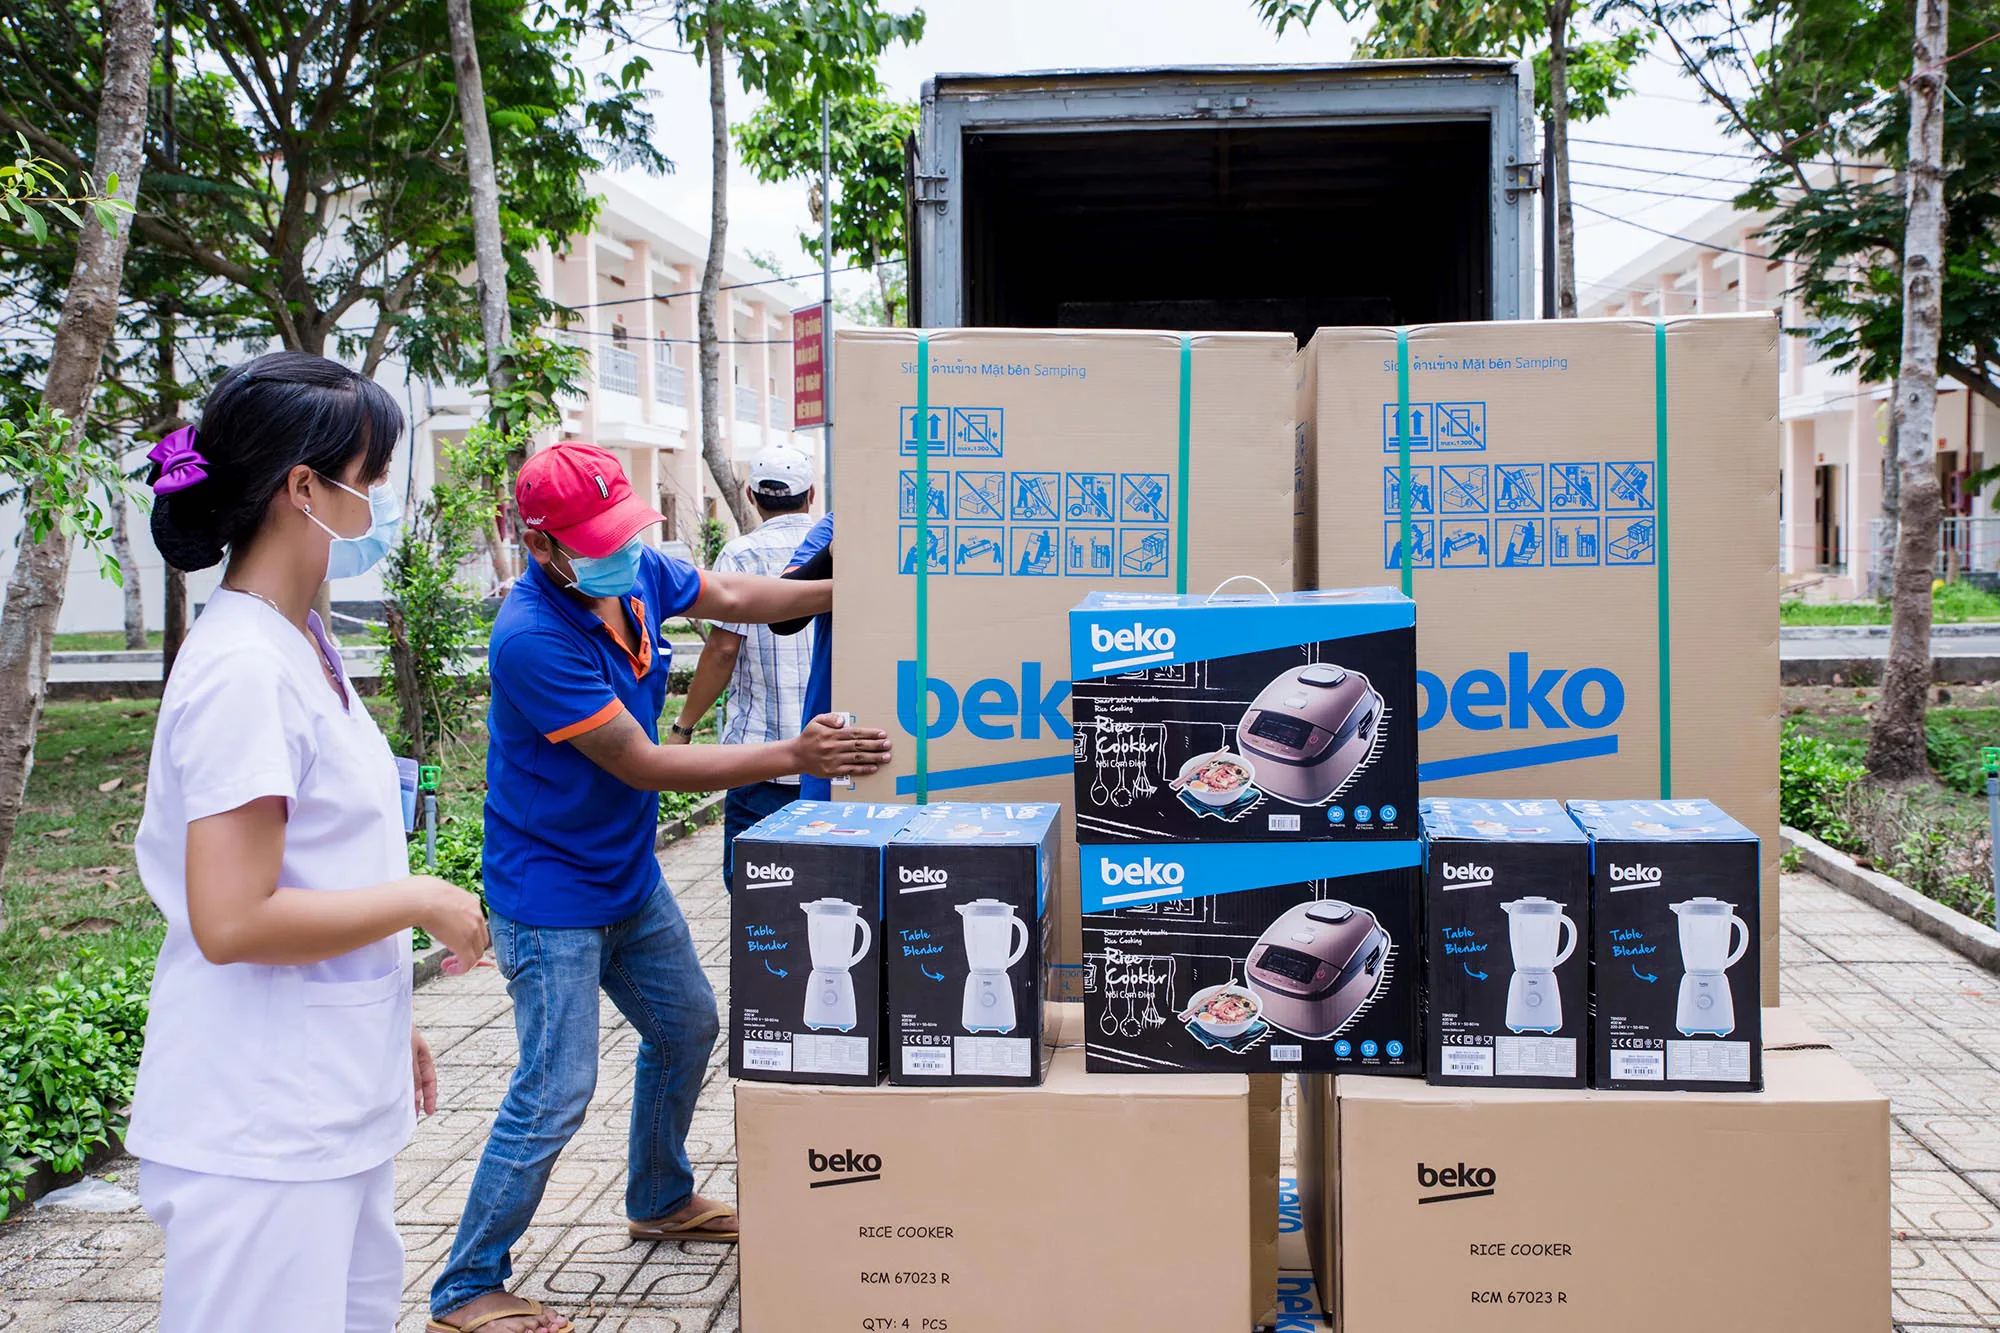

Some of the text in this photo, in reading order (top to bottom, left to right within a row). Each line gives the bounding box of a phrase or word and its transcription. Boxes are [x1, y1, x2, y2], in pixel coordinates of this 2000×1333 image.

[902, 361, 918, 374] Si
[981, 363, 1004, 378] Mật
[1007, 363, 1030, 376] bên
[1034, 364, 1087, 379] Samping
[1384, 360, 1399, 372] Si
[1462, 358, 1485, 372] Mật
[1488, 358, 1512, 370] bên
[1515, 356, 1568, 370] Samping
[1091, 623, 1176, 651] beko
[897, 660, 1073, 740] bek
[1094, 704, 1133, 713] Rice Cooking
[1094, 715, 1134, 733] Rice
[1097, 734, 1158, 753] Cooker
[746, 861, 794, 881] beko
[899, 866, 948, 884] beko
[1101, 857, 1184, 886] beko
[1443, 862, 1494, 881] beko
[1610, 863, 1662, 881] beko
[745, 925, 775, 936] Table
[900, 929, 931, 941] Table
[1442, 926, 1475, 939] Table
[1609, 928, 1643, 941] Table
[747, 941, 788, 952] Blender
[1104, 936, 1142, 946] Rice Cooking
[1444, 942, 1488, 955] Blender
[902, 944, 944, 957] Blender
[1104, 947, 1143, 965] Rice
[1612, 944, 1656, 957] Blender
[1106, 968, 1167, 985] Cooker
[808, 1149, 882, 1173] beko
[1418, 1163, 1496, 1188] beko
[859, 1226, 954, 1239] RICE COOKER
[1470, 1243, 1572, 1257] RICE COOKER
[861, 1271, 950, 1285] RCM 67023 R
[1471, 1291, 1568, 1304] RCM 67023 R
[862, 1318, 948, 1332] QTY: 4 PCS
